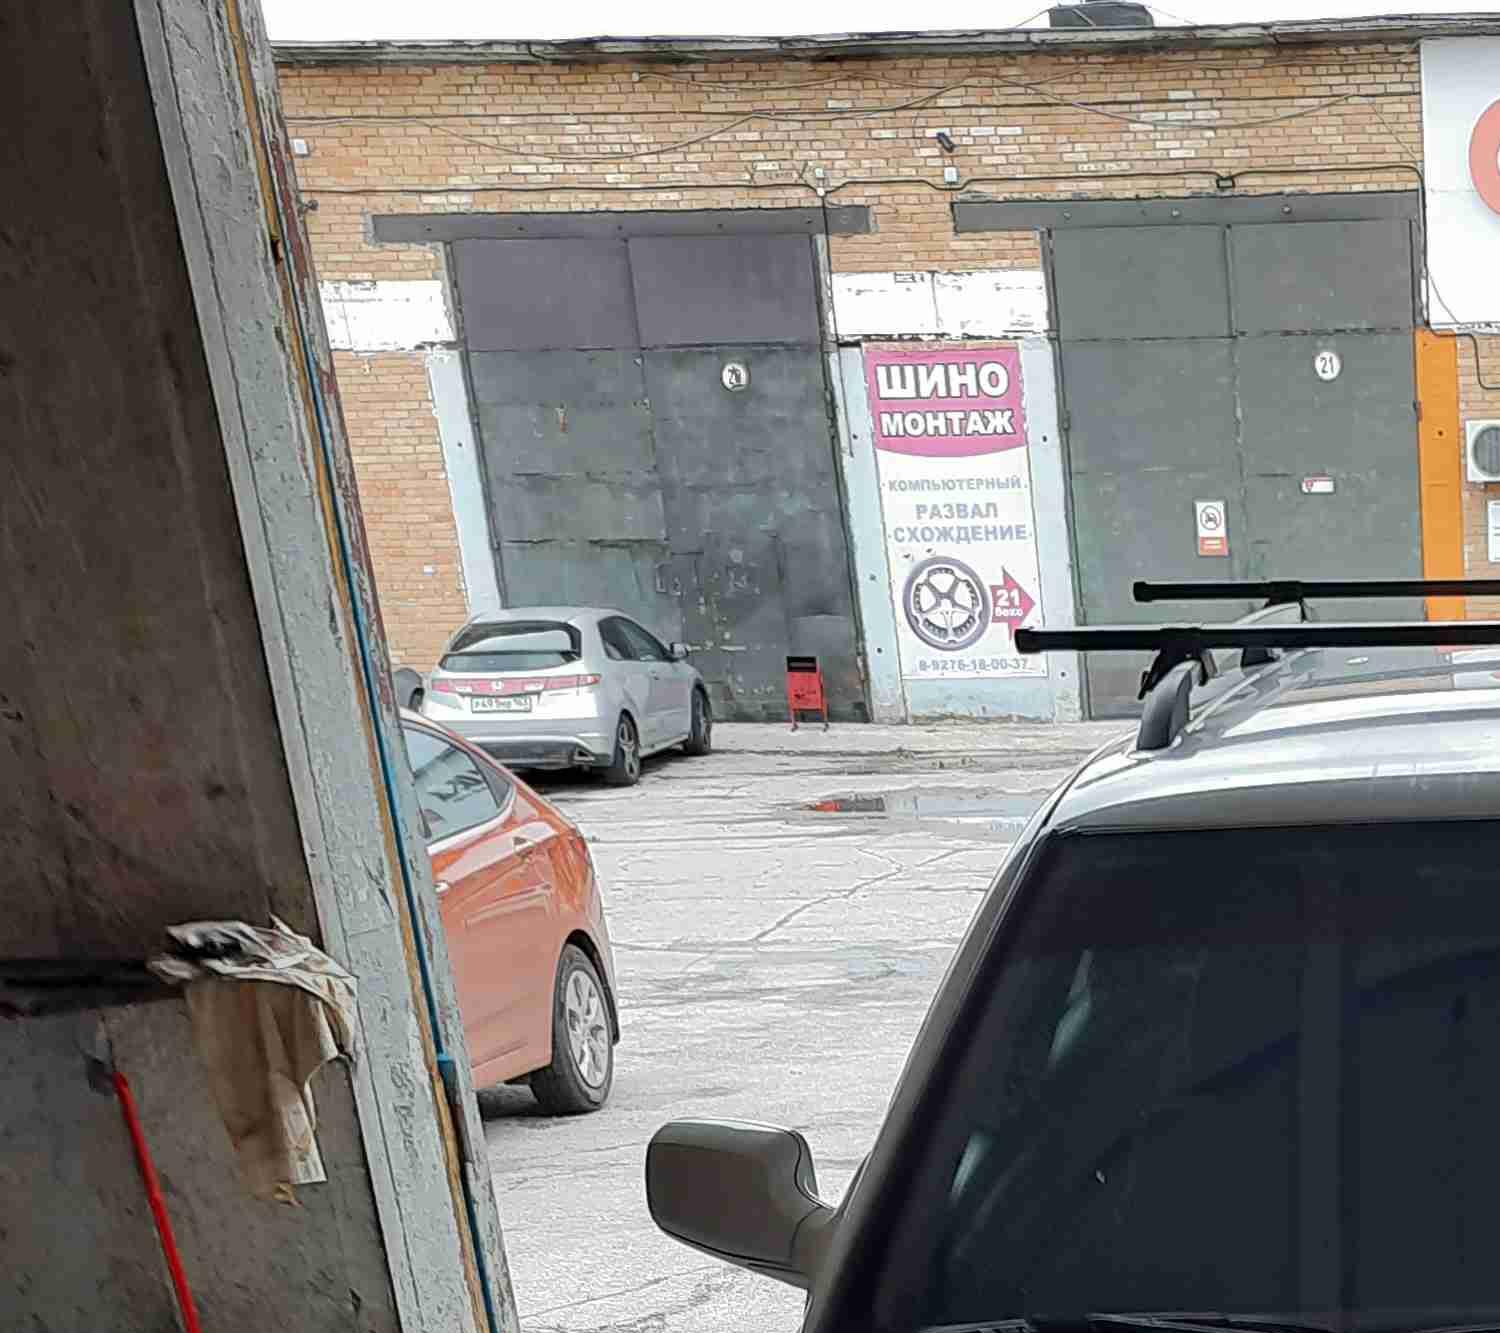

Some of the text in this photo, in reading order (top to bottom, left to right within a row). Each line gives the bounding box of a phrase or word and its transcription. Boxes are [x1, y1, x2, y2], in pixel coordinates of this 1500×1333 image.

[1320, 356, 1335, 375] 21
[876, 361, 1009, 400] ШИНО
[879, 409, 1016, 438] МОНТАЖ
[888, 475, 1022, 492] КОМПЬЮТЕРНЫЙ
[915, 502, 999, 520] РАЗВАЛ
[893, 524, 1027, 544] СХОЖДЕНИЕ
[996, 588, 1020, 607] 21
